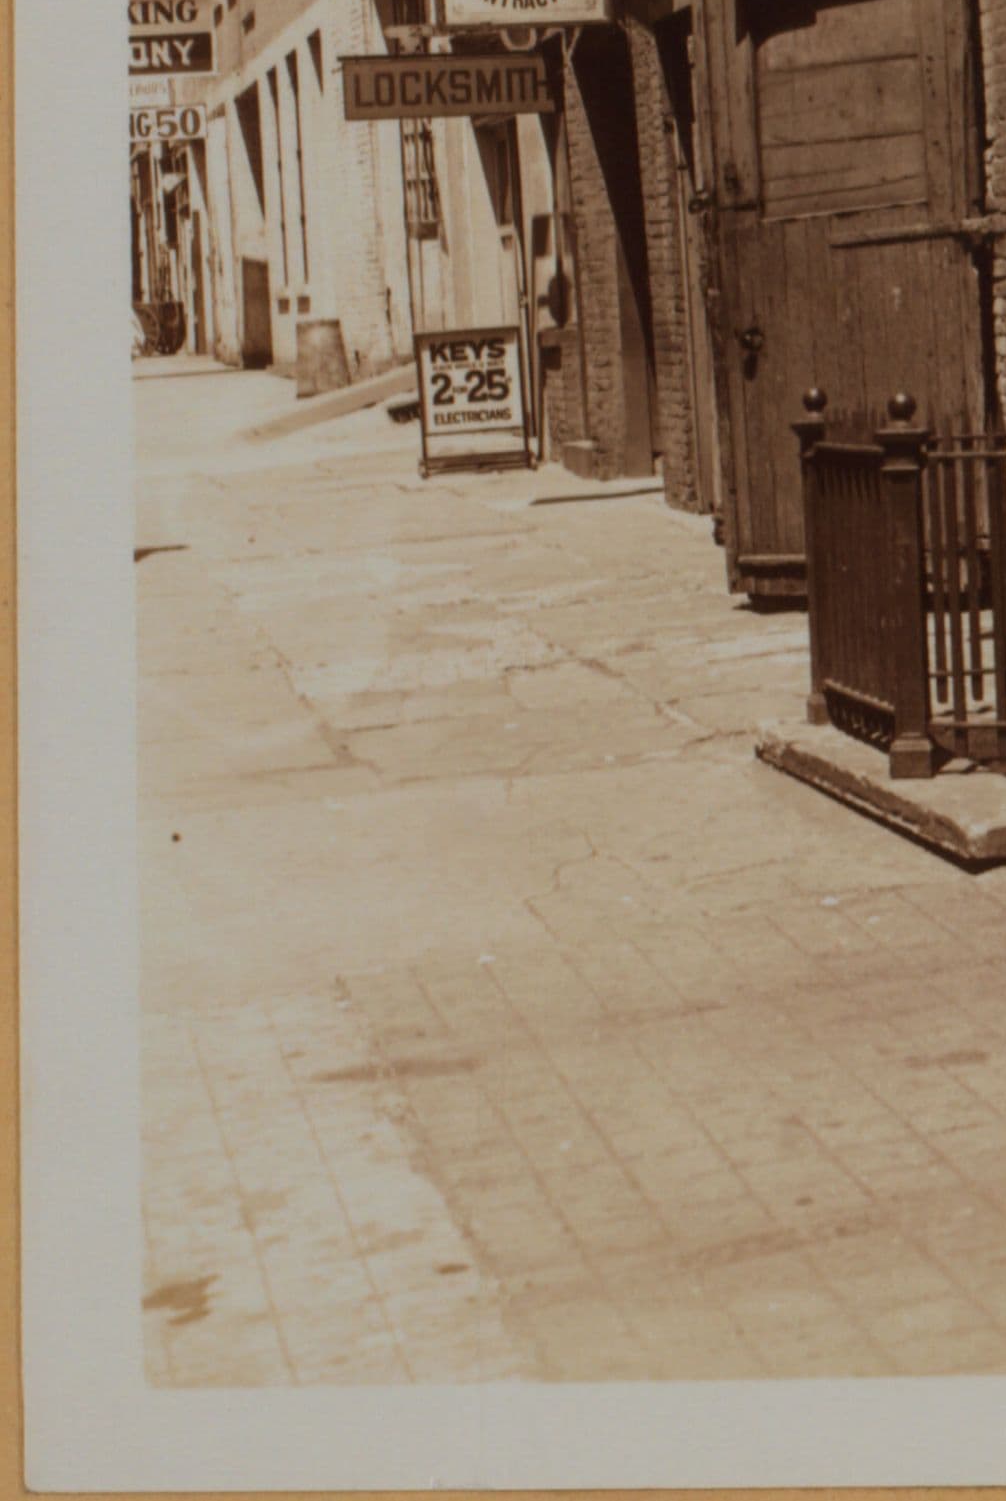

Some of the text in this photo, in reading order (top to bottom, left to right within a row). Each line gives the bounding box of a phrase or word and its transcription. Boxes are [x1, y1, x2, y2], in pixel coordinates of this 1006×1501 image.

[352, 64, 551, 109] LOCKSMITH
[156, 107, 200, 138] 50
[429, 339, 506, 364] KEYS
[431, 373, 455, 406] 2
[434, 408, 512, 426] ELECTRICIANS
